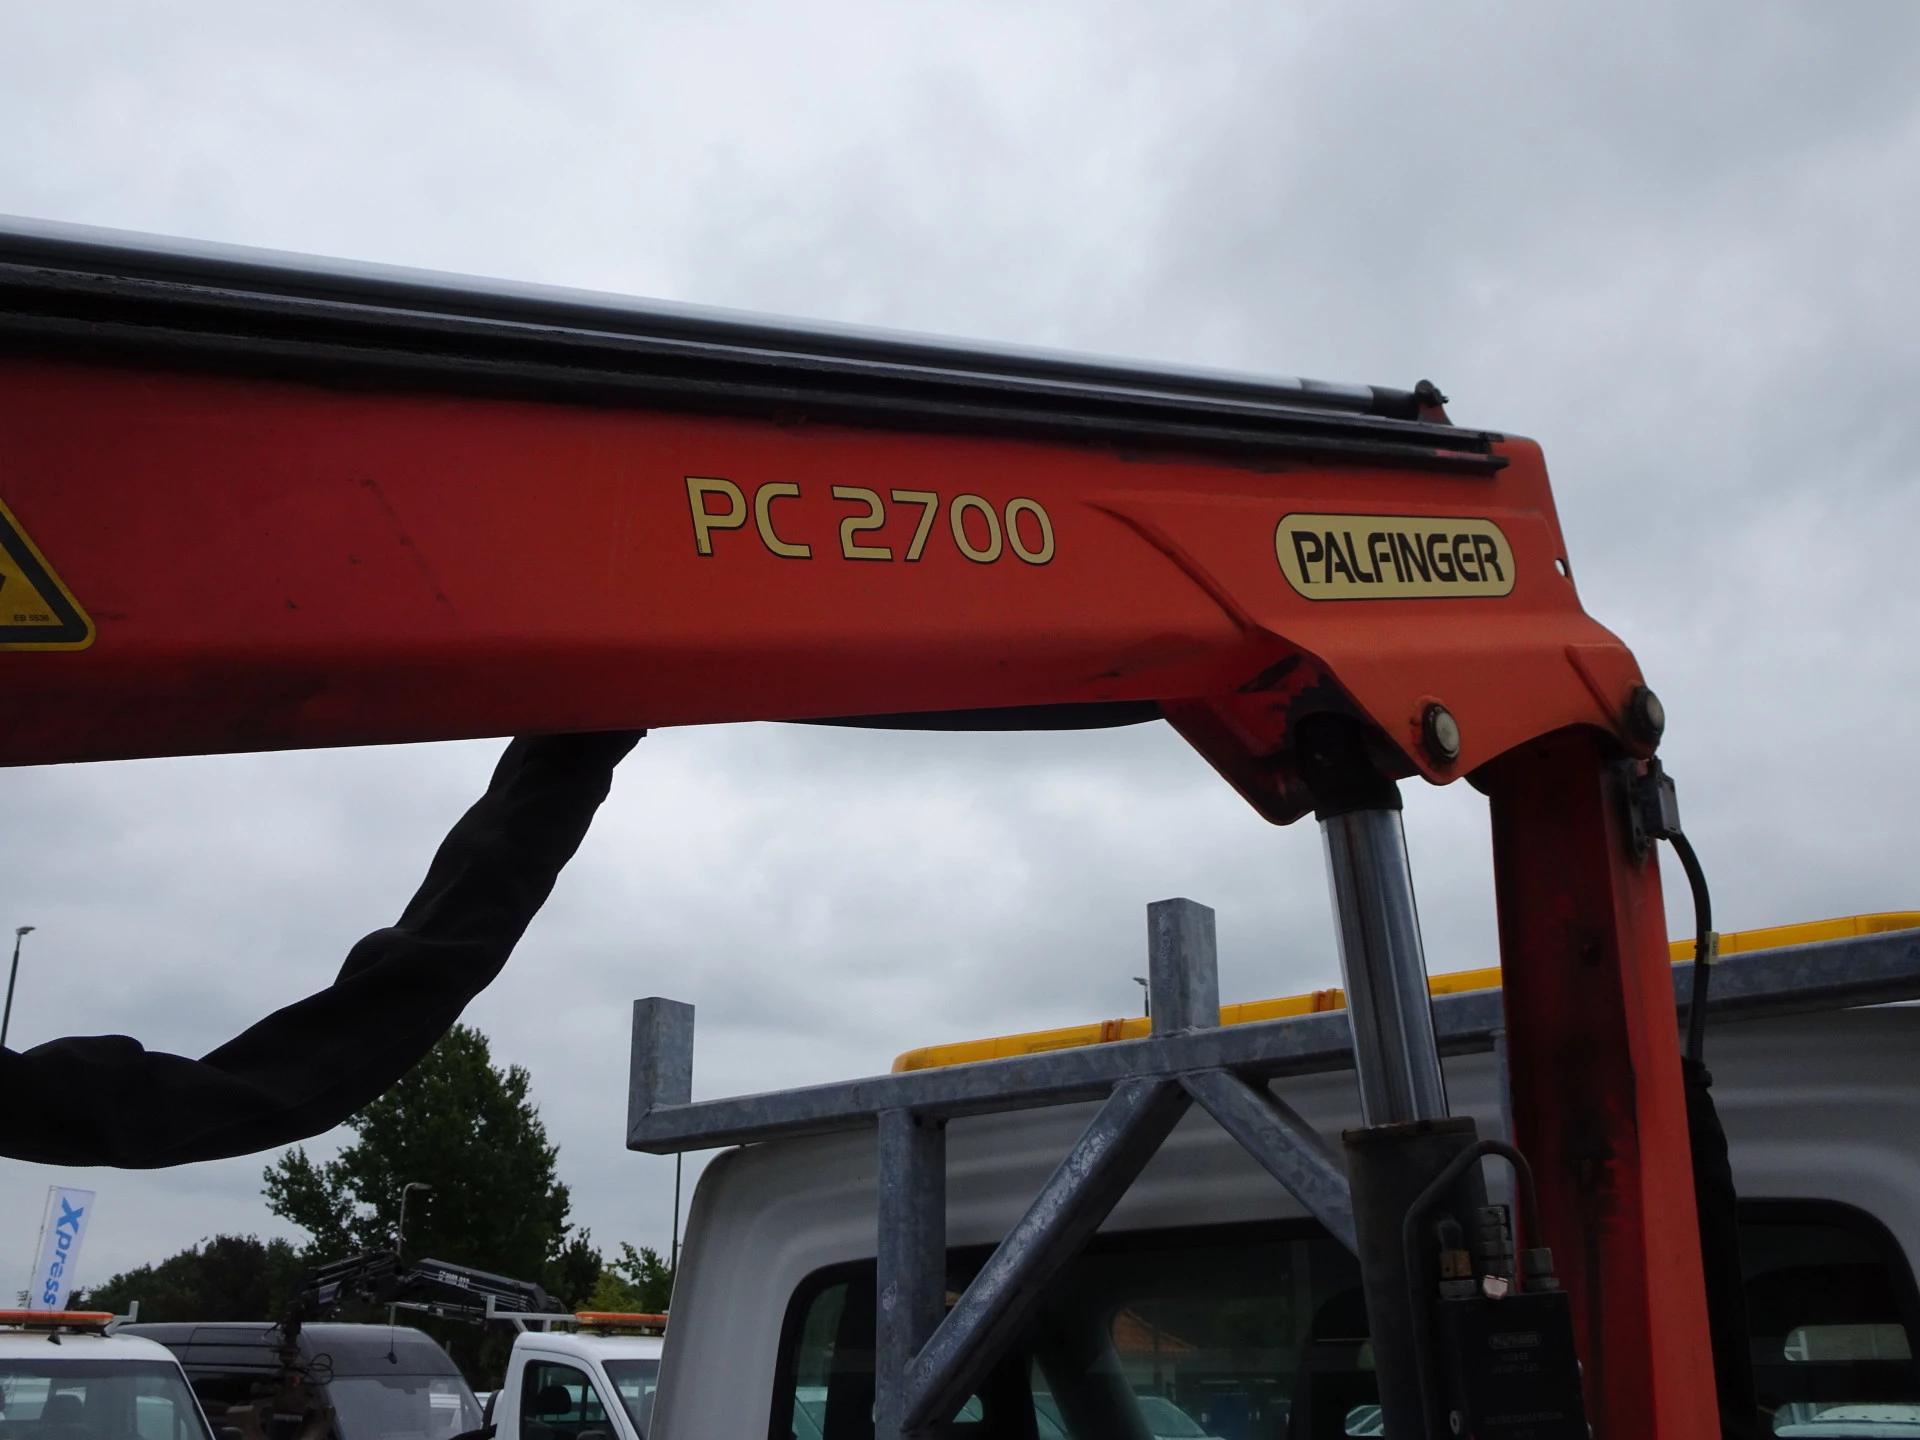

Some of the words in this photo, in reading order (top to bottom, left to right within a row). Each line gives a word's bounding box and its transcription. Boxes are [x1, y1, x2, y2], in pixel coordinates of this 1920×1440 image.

[684, 476, 812, 560] PC
[831, 485, 1056, 566] 2700
[1291, 531, 1505, 584] PALFINGER
[13, 614, 27, 622] EB
[43, 1196, 84, 1305] Xpress
